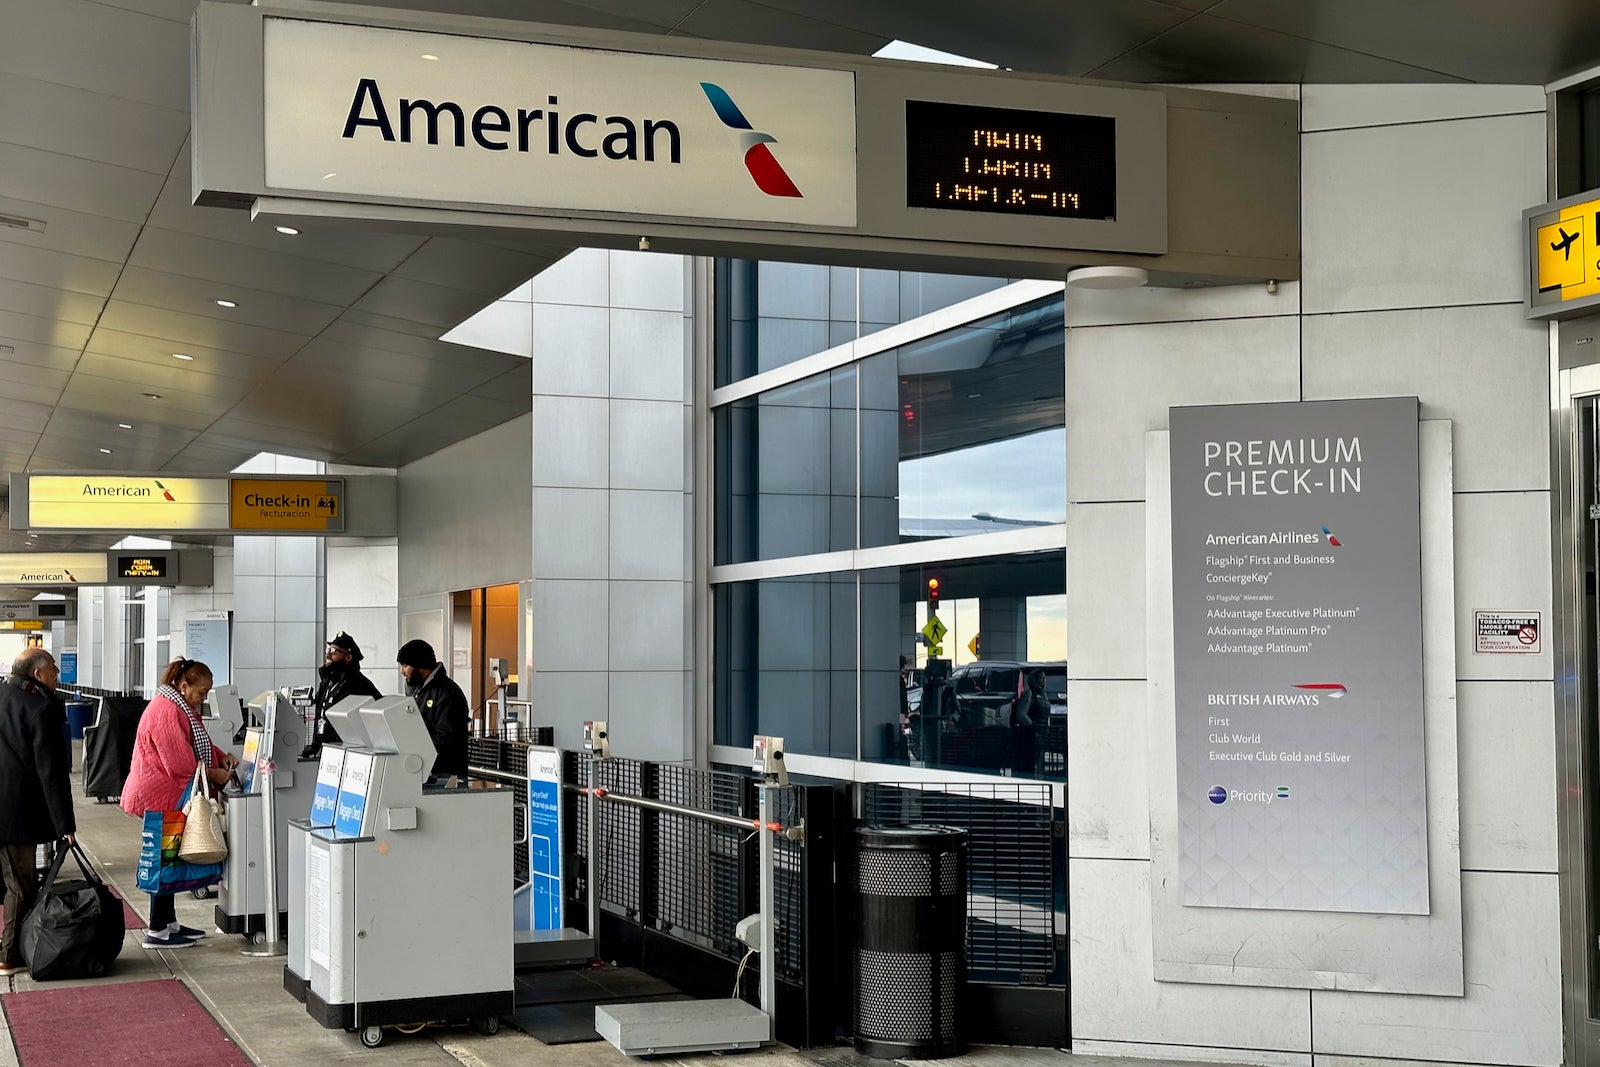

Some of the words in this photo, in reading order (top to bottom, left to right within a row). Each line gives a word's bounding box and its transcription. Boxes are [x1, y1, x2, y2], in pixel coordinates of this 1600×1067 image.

[341, 78, 681, 164] American
[1204, 437, 1362, 467] PREMIUM
[1204, 467, 1362, 497] CHECK-IN
[82, 484, 151, 497] American
[244, 494, 310, 508] Check-in
[1205, 532, 1267, 545] American
[1268, 531, 1319, 544] Airlines
[1249, 555, 1271, 565] First
[1273, 554, 1291, 565] and
[1293, 554, 1335, 565] Business
[20, 572, 64, 581] American
[1206, 594, 1216, 602] On
[1206, 608, 1263, 622] AAdvantage
[1265, 608, 1311, 619] Executive
[1207, 625, 1264, 639] AAdvantage
[1265, 625, 1308, 636] Platinum
[1207, 642, 1264, 656] AAdvantage
[1208, 694, 1260, 706] BRITISH
[1262, 694, 1320, 706] AIRWAYS
[1208, 716, 1230, 727] First
[1208, 733, 1230, 744] Club
[1232, 733, 1261, 744] World
[1209, 750, 1254, 762] Executive
[1255, 751, 1278, 762] Club
[1279, 751, 1302, 762] Gold
[1303, 752, 1322, 763] and
[1324, 752, 1352, 763] Silver
[1230, 789, 1274, 805] Priority
